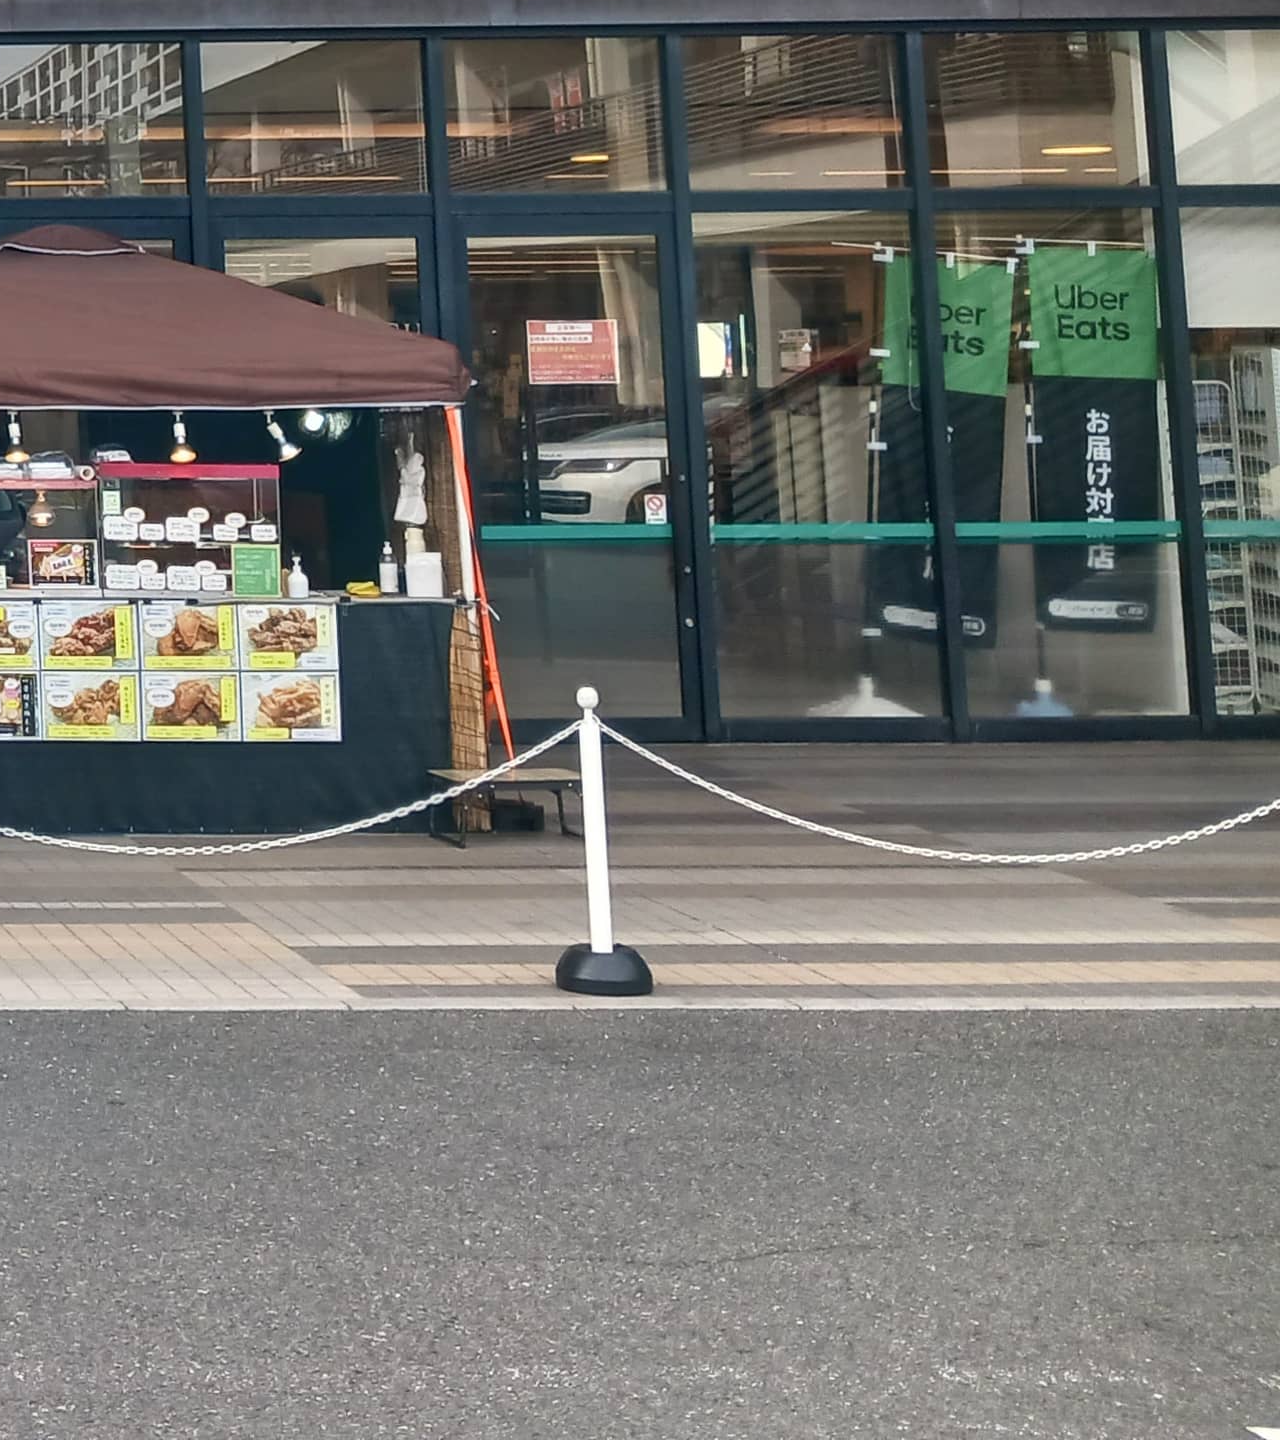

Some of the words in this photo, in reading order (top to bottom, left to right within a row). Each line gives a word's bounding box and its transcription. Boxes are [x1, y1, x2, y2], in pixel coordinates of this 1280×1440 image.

[1053, 284, 1130, 311] Uber
[1056, 314, 1131, 341] Eats
[1085, 408, 1115, 570] お届け対店
